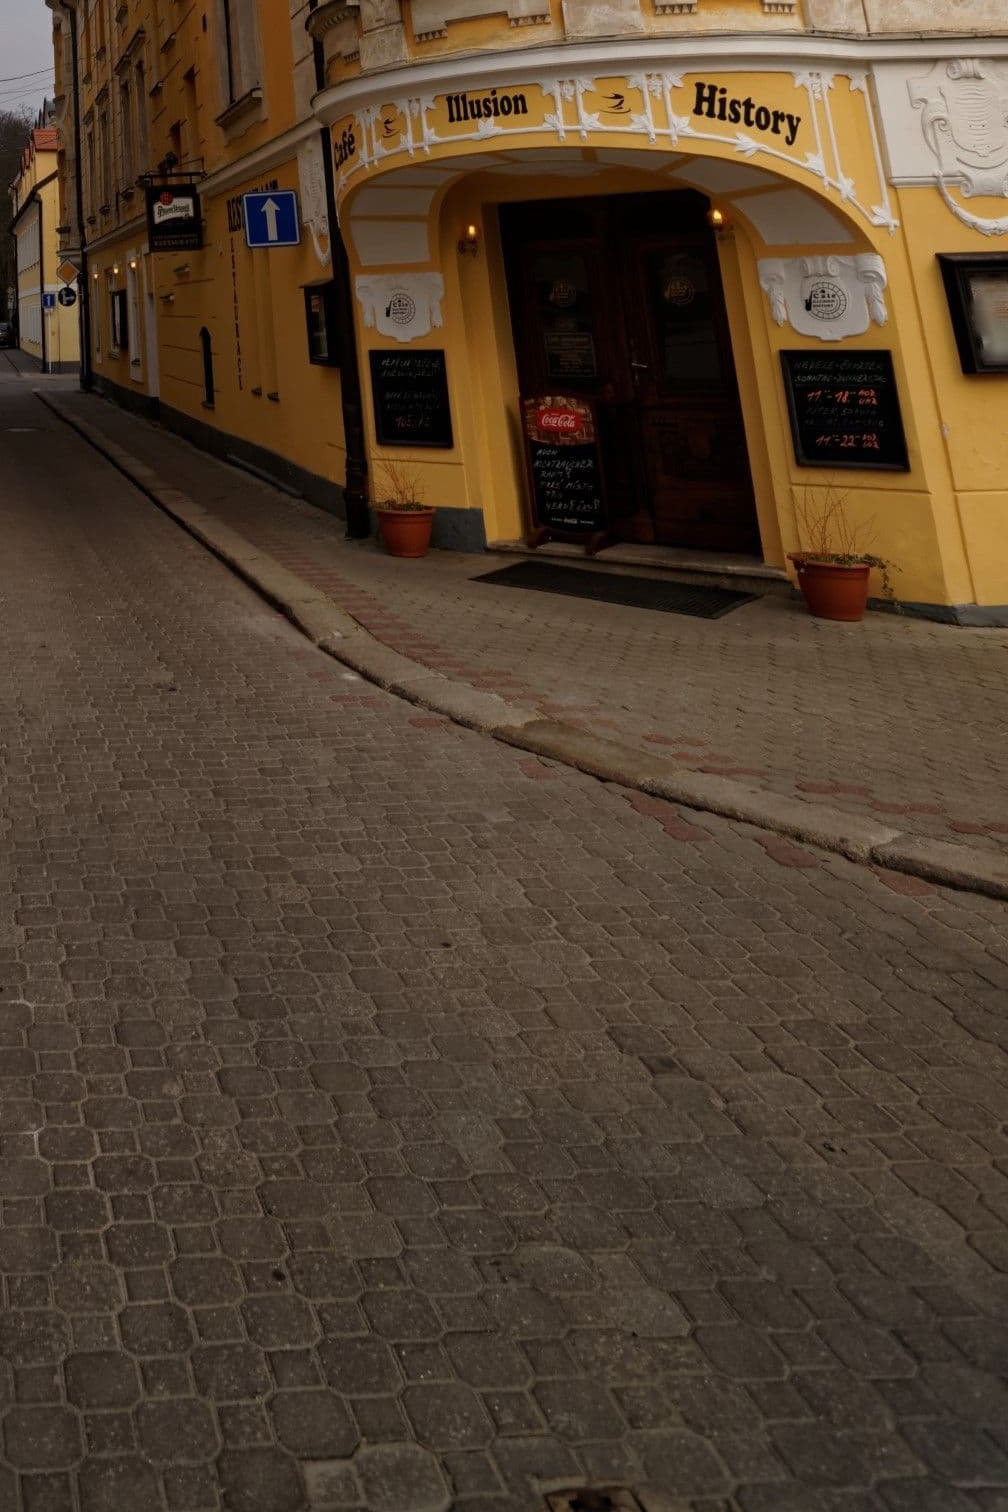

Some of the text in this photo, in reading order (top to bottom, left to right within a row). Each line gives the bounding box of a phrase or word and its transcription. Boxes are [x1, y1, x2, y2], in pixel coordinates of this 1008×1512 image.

[335, 82, 801, 172] Café Illusion History
